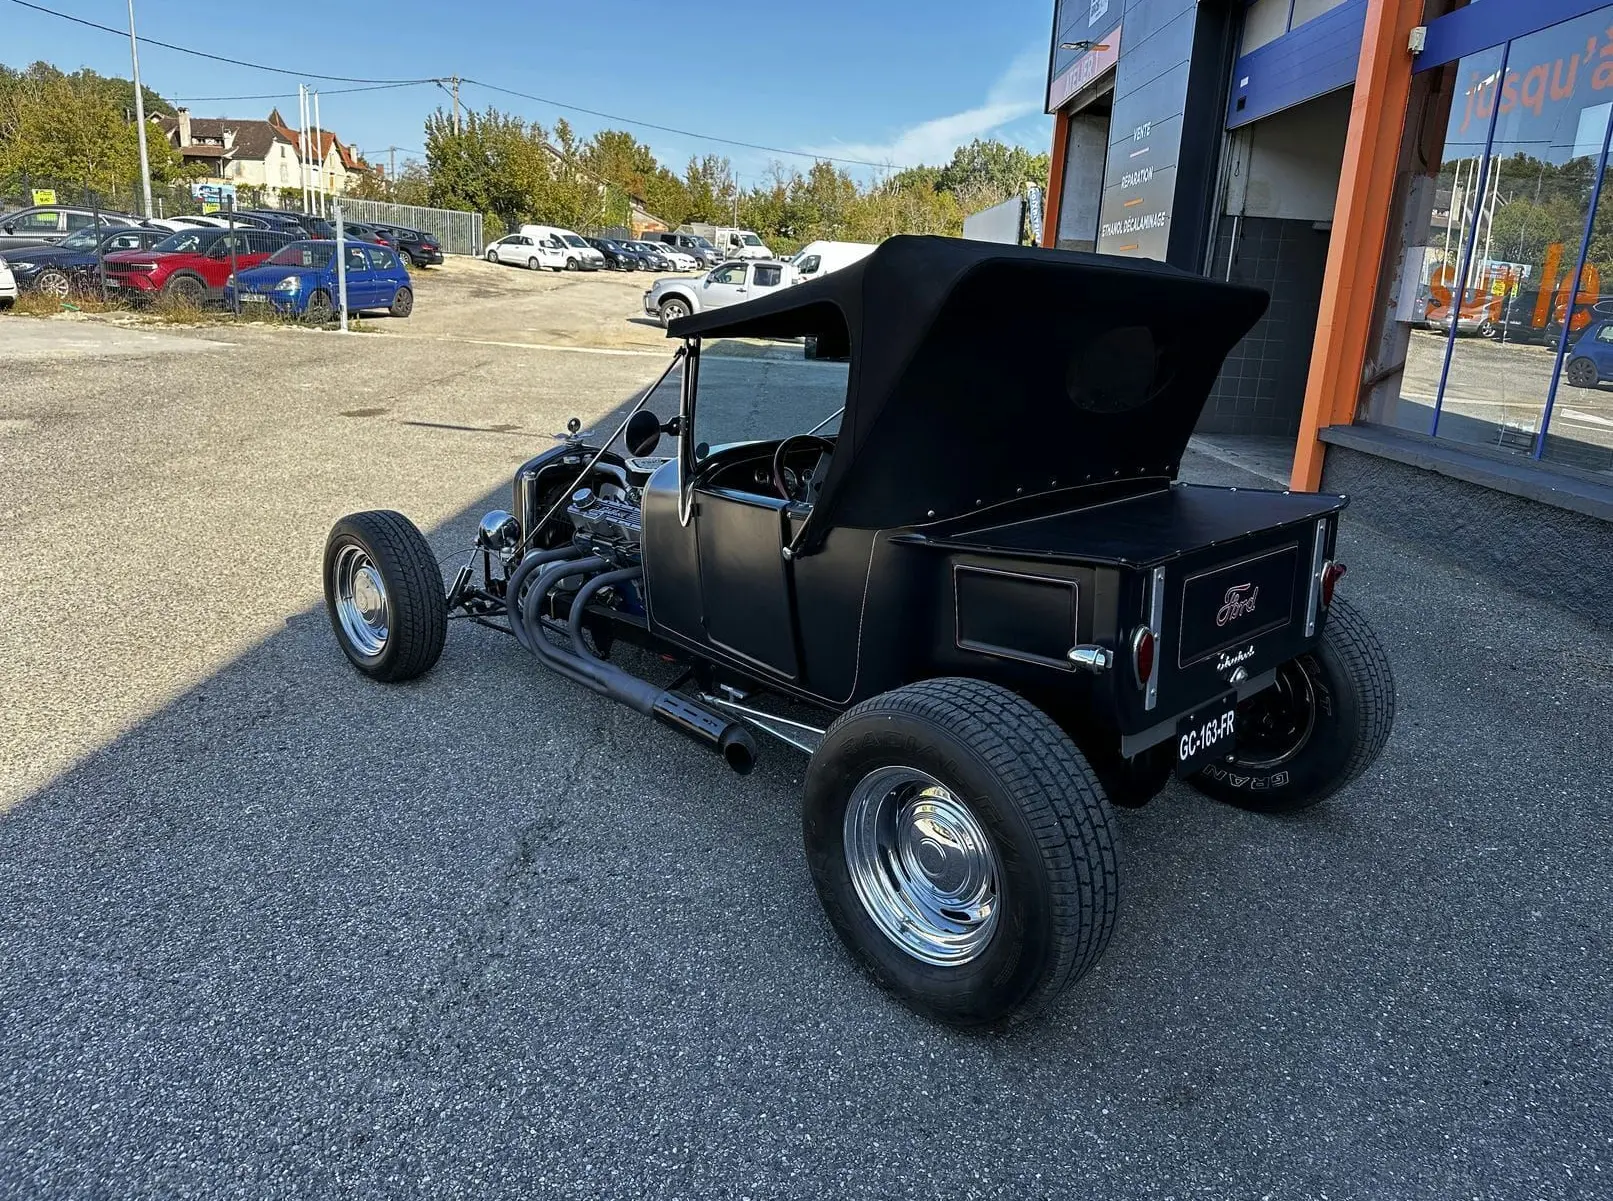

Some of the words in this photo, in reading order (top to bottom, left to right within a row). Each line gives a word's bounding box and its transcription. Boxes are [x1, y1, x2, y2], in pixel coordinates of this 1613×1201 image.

[1133, 121, 1153, 142] VENTE
[1121, 166, 1154, 189] RÉPARATION
[1123, 211, 1166, 234] DÉCALAMINAGE
[1531, 242, 1600, 332] le
[1216, 583, 1259, 627] Ford
[1180, 710, 1235, 761] GC-163-FR
